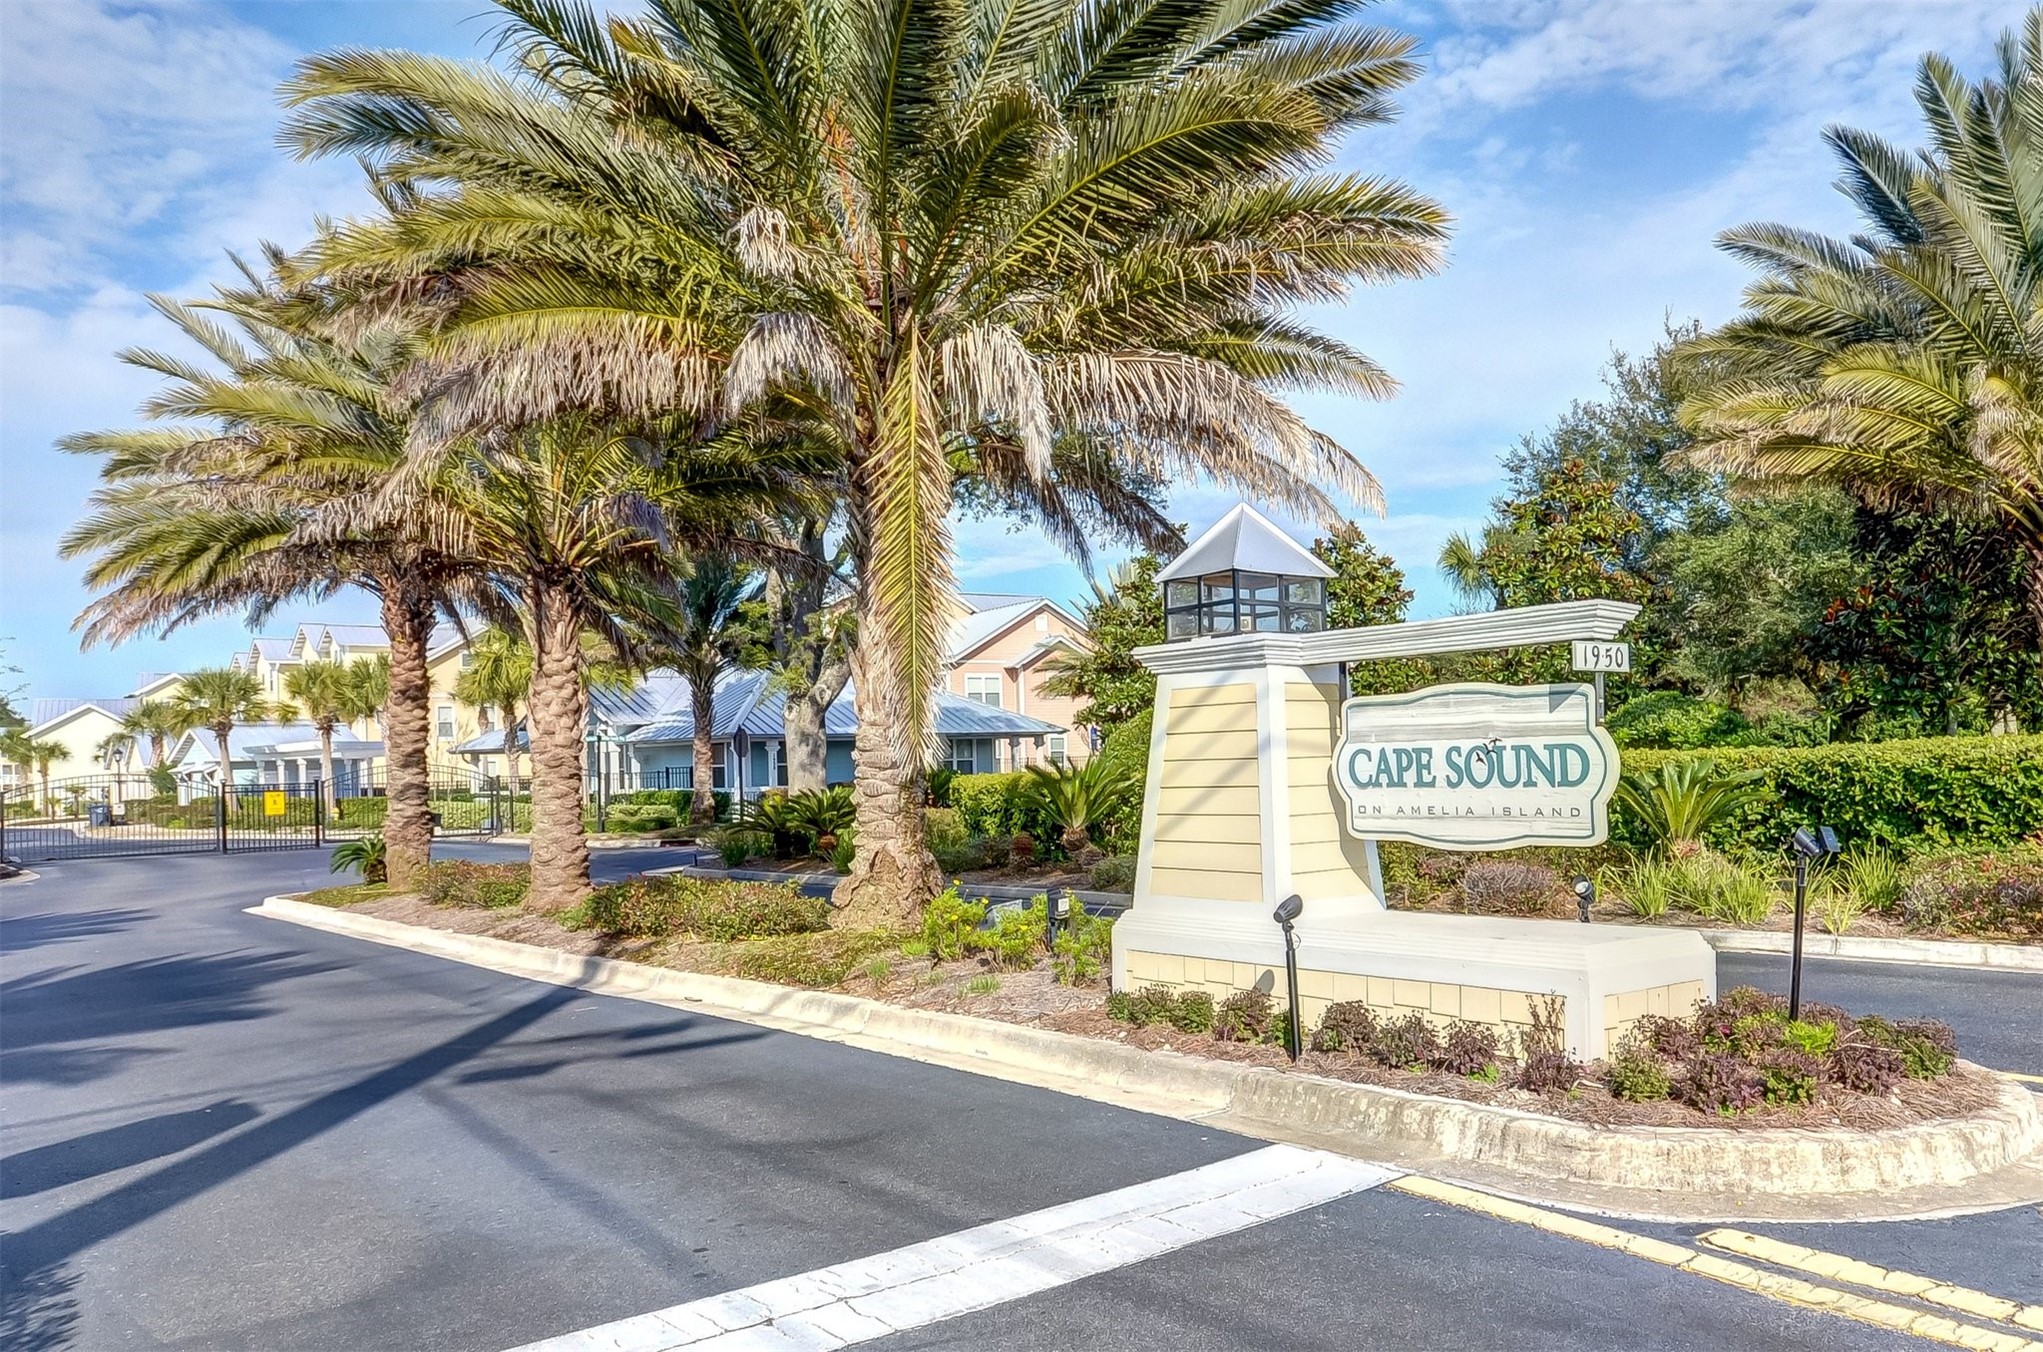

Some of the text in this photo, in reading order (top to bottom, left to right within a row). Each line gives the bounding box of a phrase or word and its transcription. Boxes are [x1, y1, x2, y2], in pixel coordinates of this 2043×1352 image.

[1584, 645, 1624, 669] 1950
[1349, 743, 1590, 789] CAPE SOUND
[1358, 805, 1581, 818] ON AMELIA ISLAND
